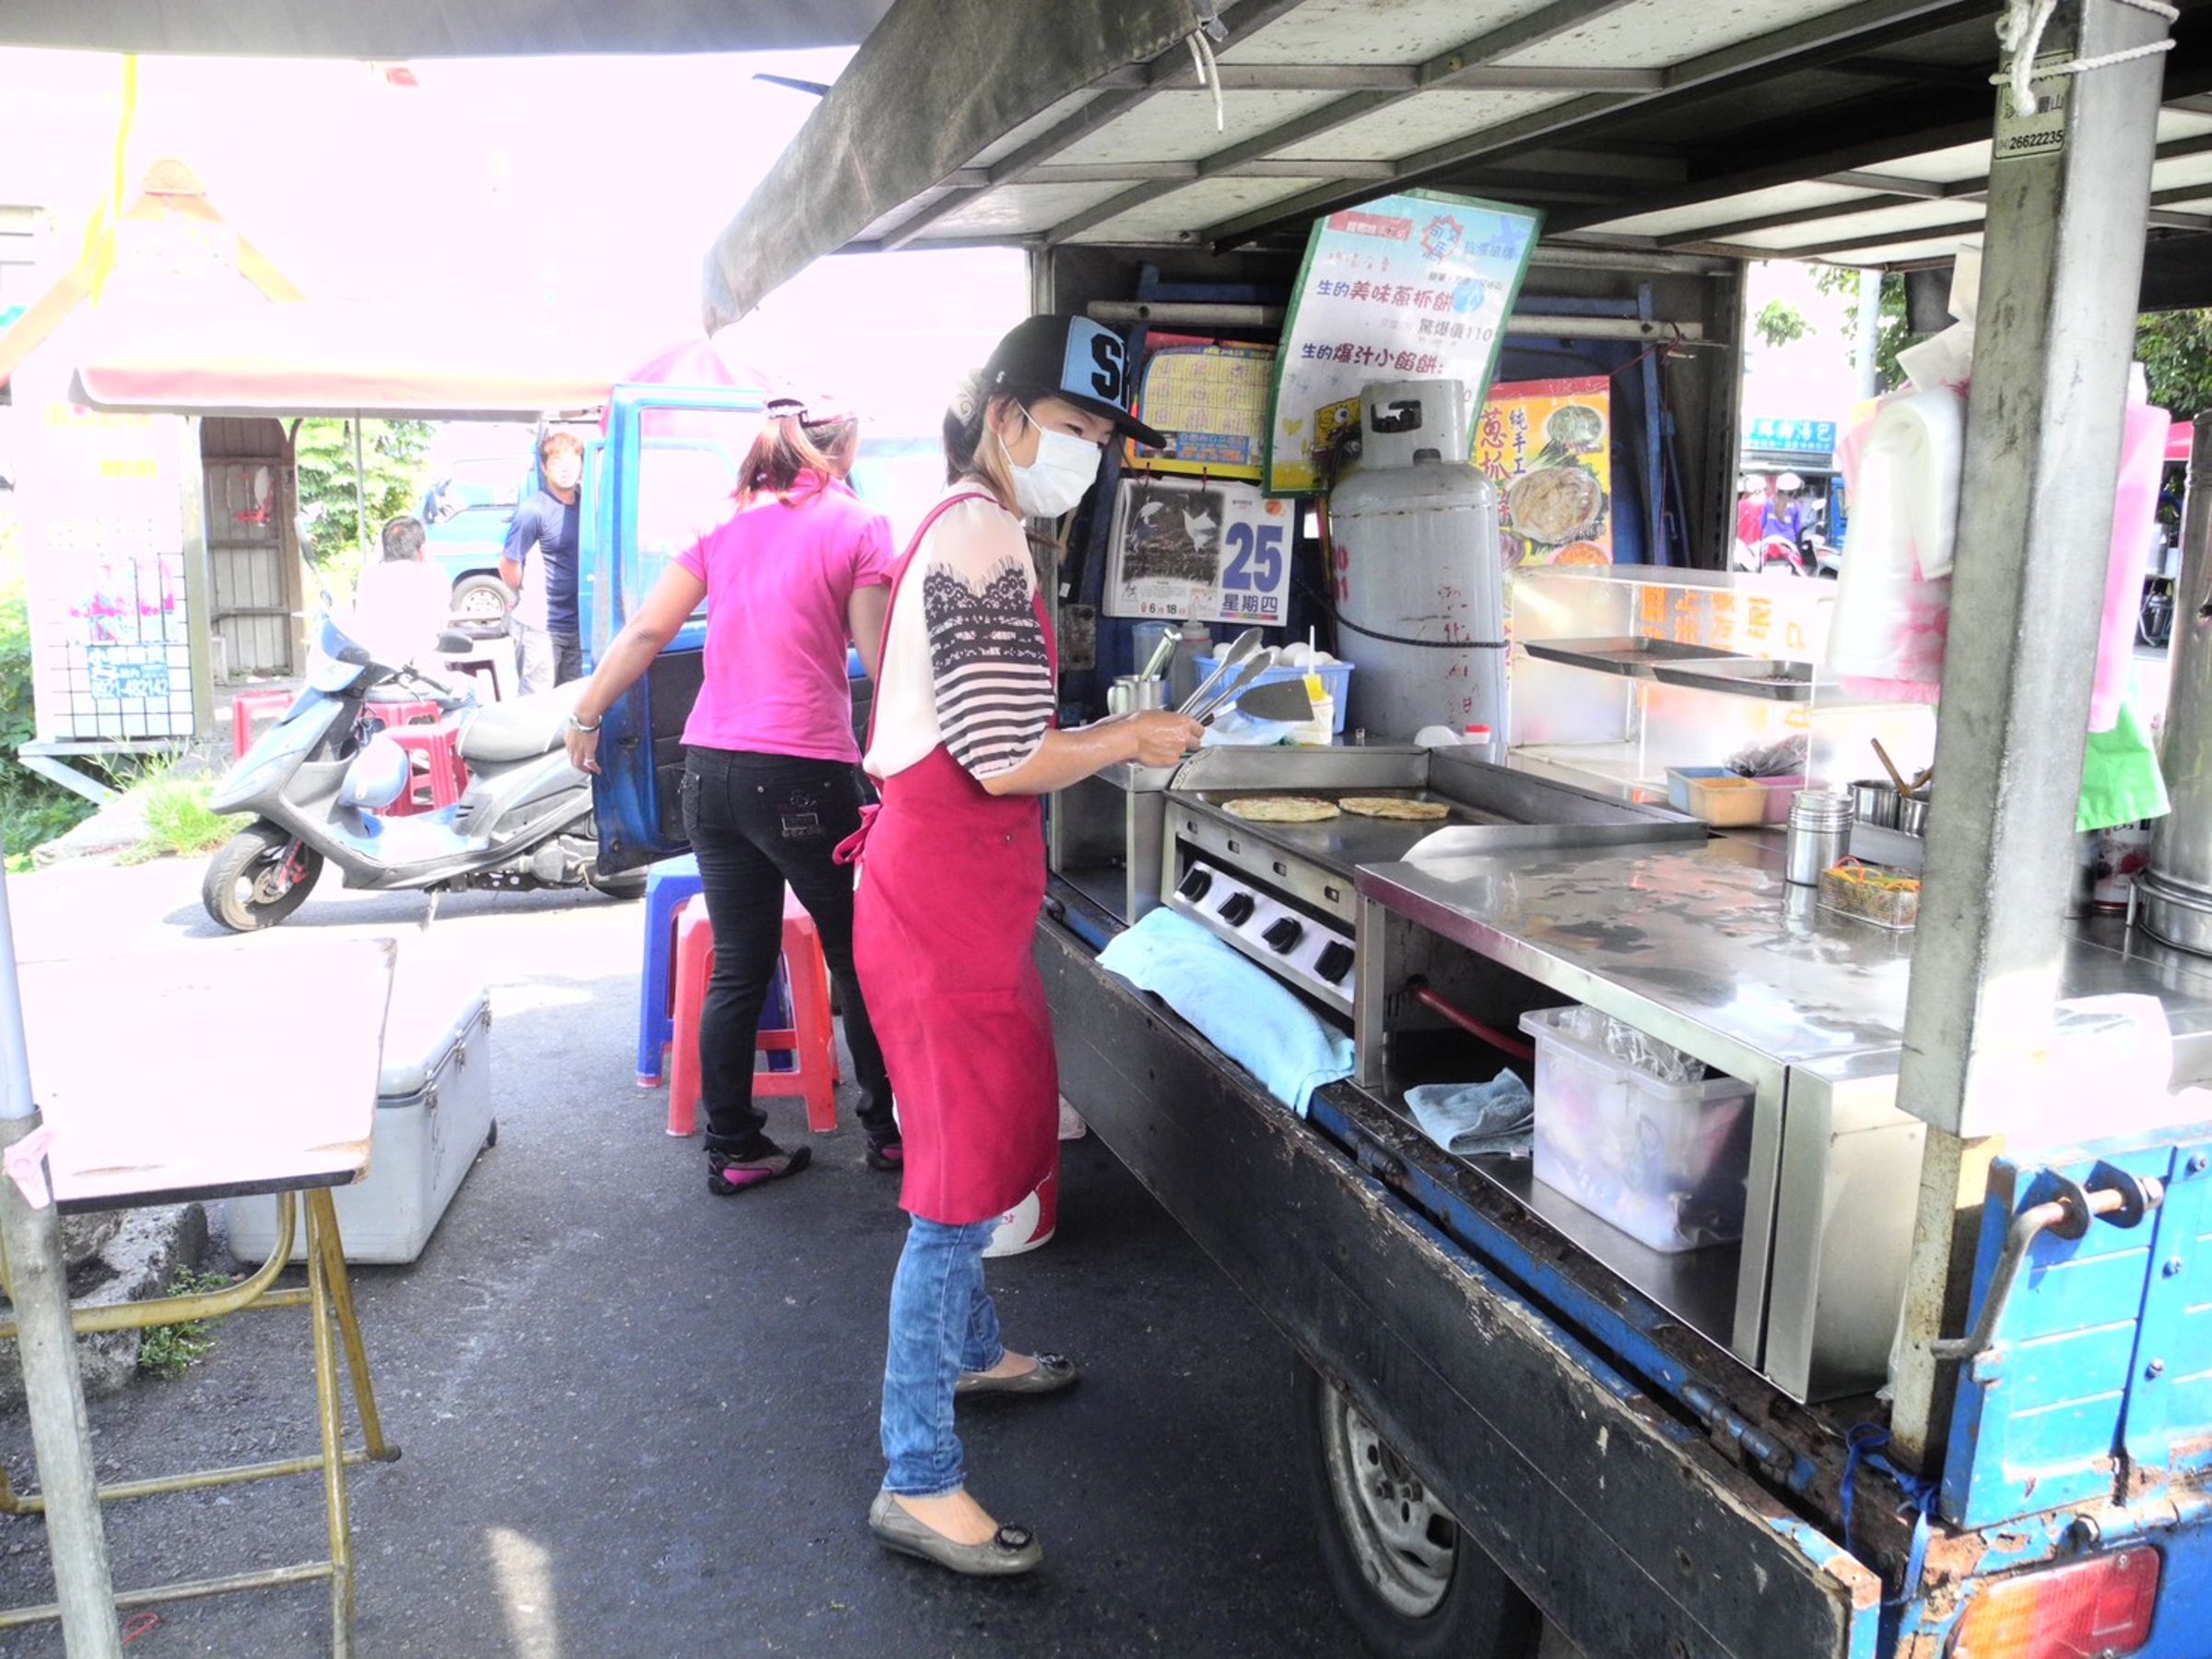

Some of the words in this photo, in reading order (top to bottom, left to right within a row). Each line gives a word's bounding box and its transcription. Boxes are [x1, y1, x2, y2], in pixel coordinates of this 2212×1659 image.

[2009, 129, 2064, 150] 26622235
[1509, 409, 1528, 475] 純手工
[1222, 522, 1284, 594] 25
[1222, 594, 1278, 614] 星期四
